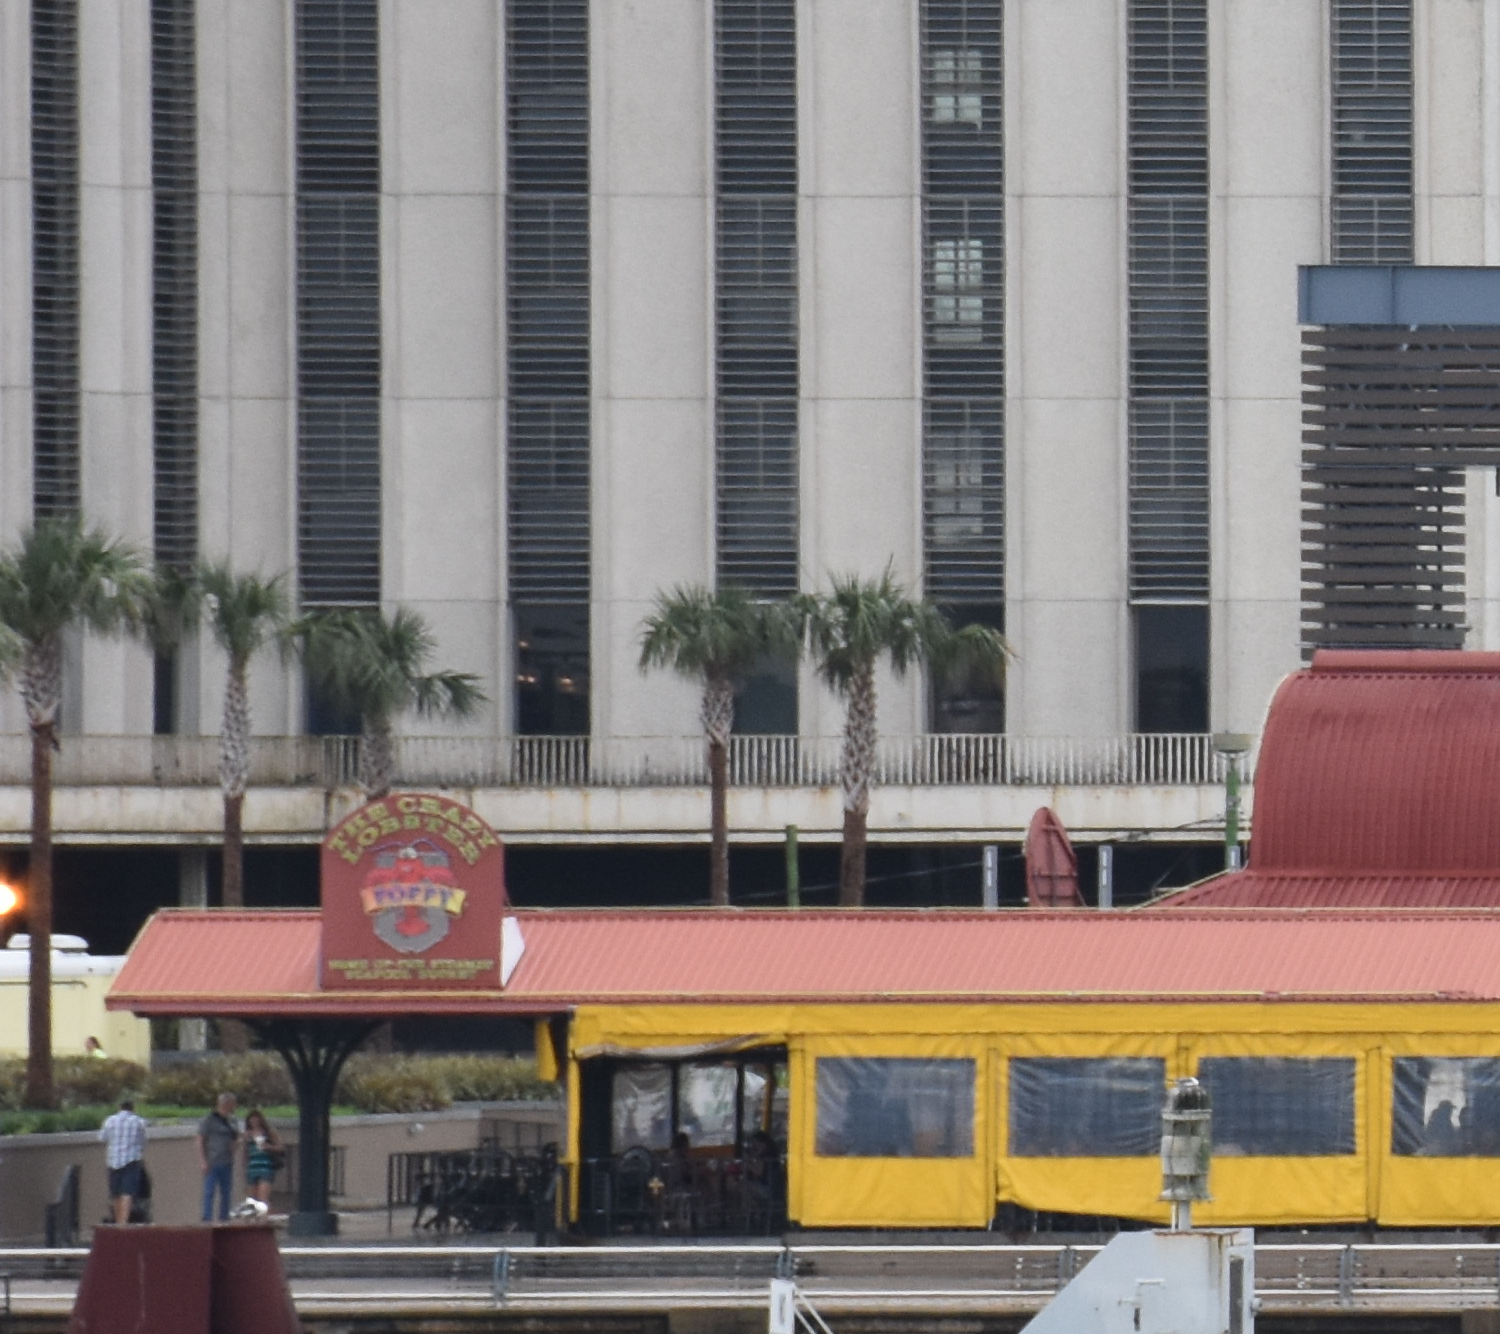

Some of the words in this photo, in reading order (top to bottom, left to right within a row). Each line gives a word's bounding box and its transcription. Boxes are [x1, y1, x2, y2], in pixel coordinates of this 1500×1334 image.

[328, 803, 389, 851] THE
[397, 797, 499, 849] CRAZY
[341, 814, 481, 866] LOBSTER
